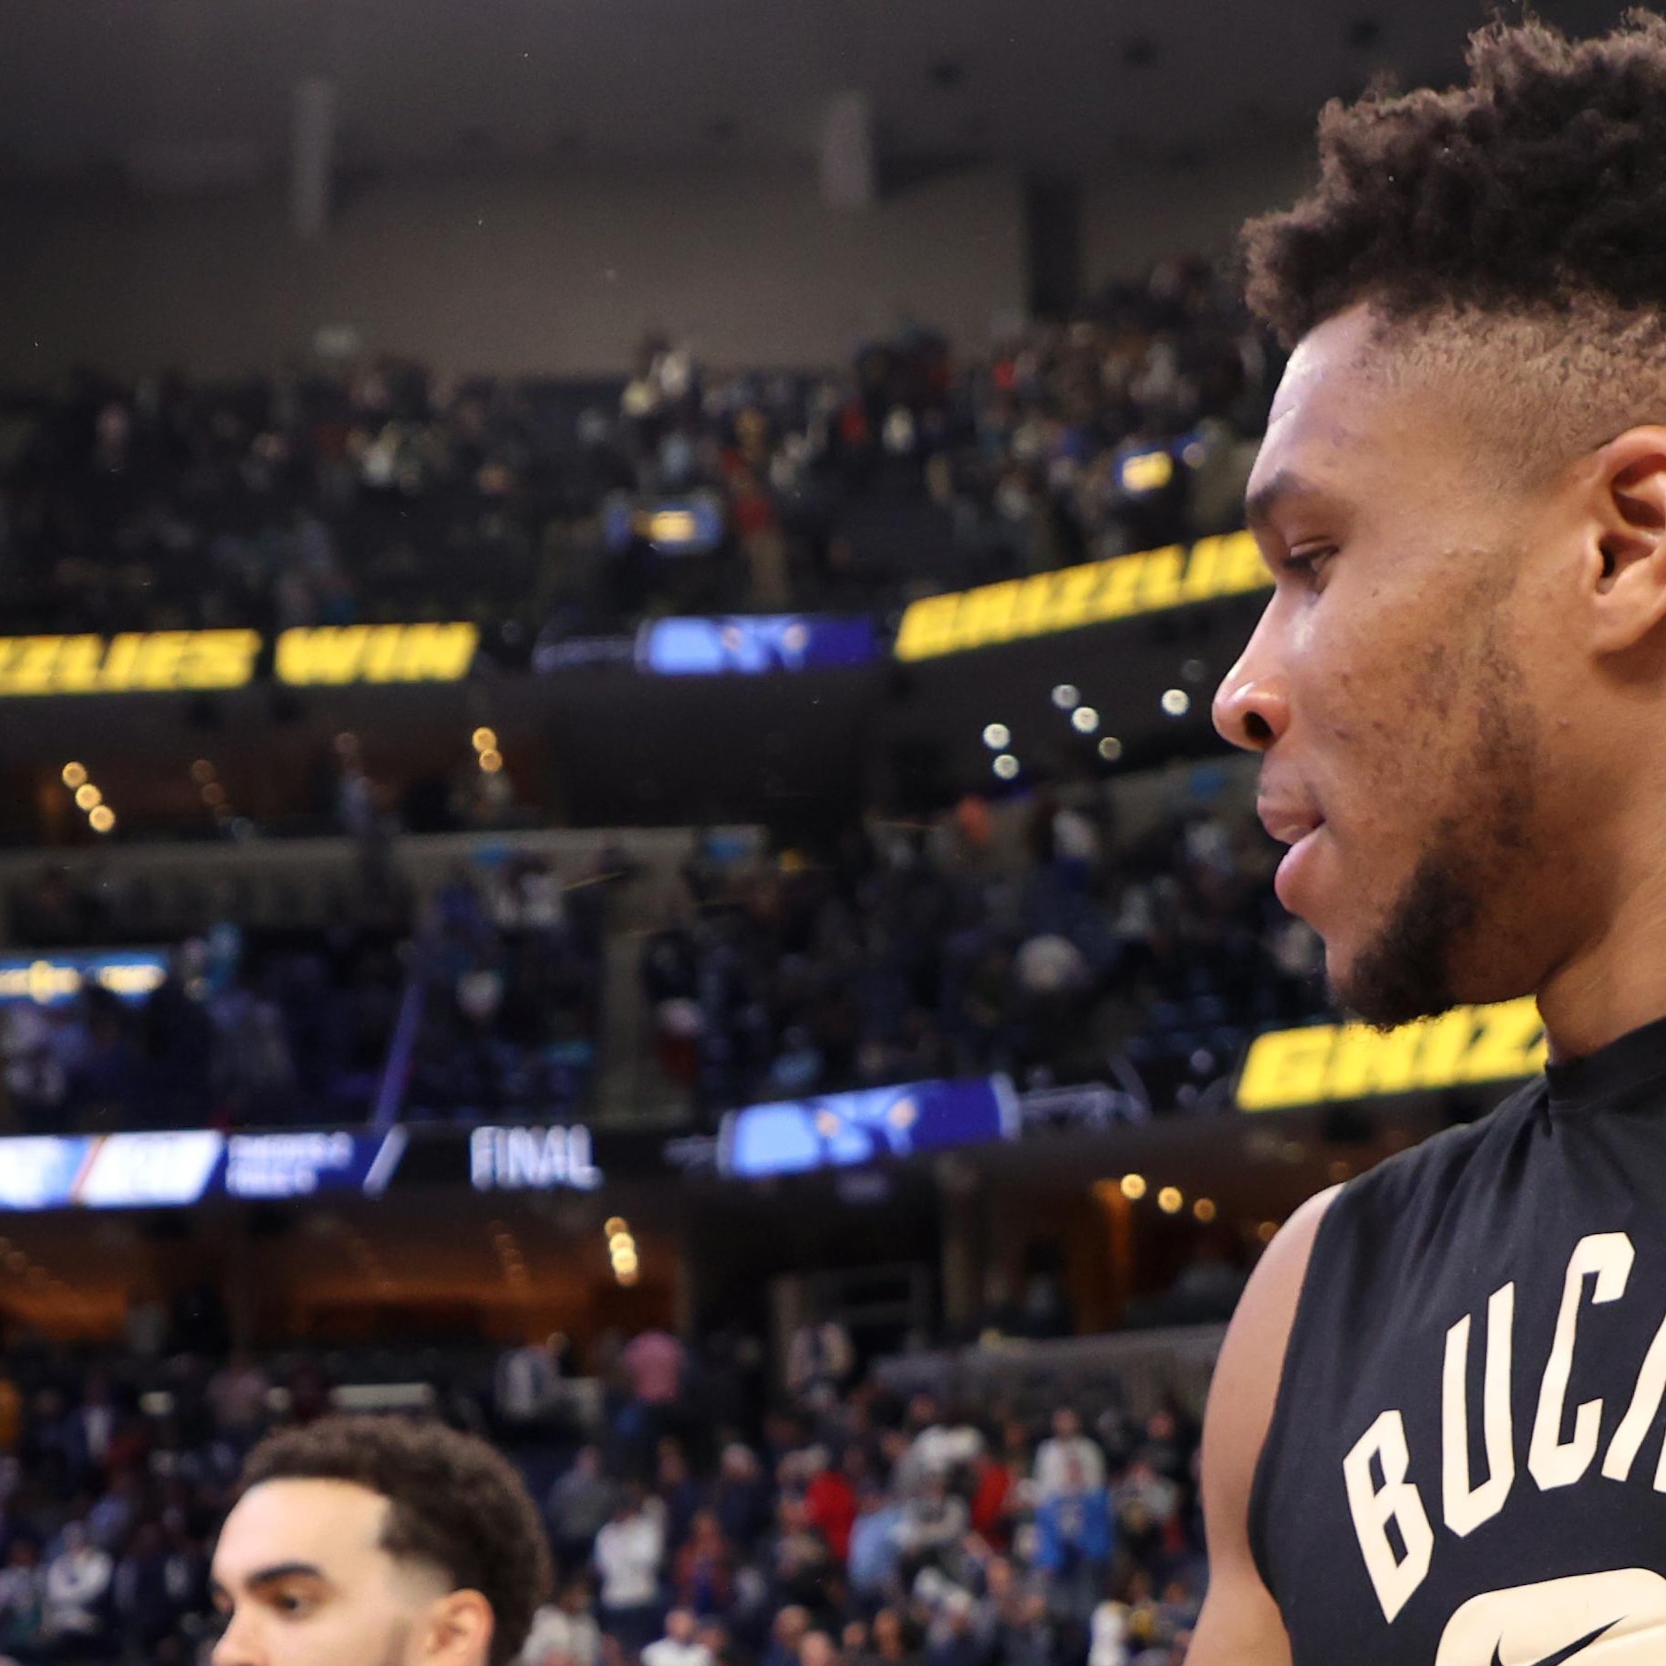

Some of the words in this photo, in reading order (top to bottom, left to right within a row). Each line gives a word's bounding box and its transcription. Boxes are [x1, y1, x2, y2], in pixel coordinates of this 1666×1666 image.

[895, 529, 1276, 661] GRIZZLIE
[275, 621, 477, 685] WIN
[1237, 995, 1550, 1110] GRIZ
[470, 1123, 601, 1191] FINAL
